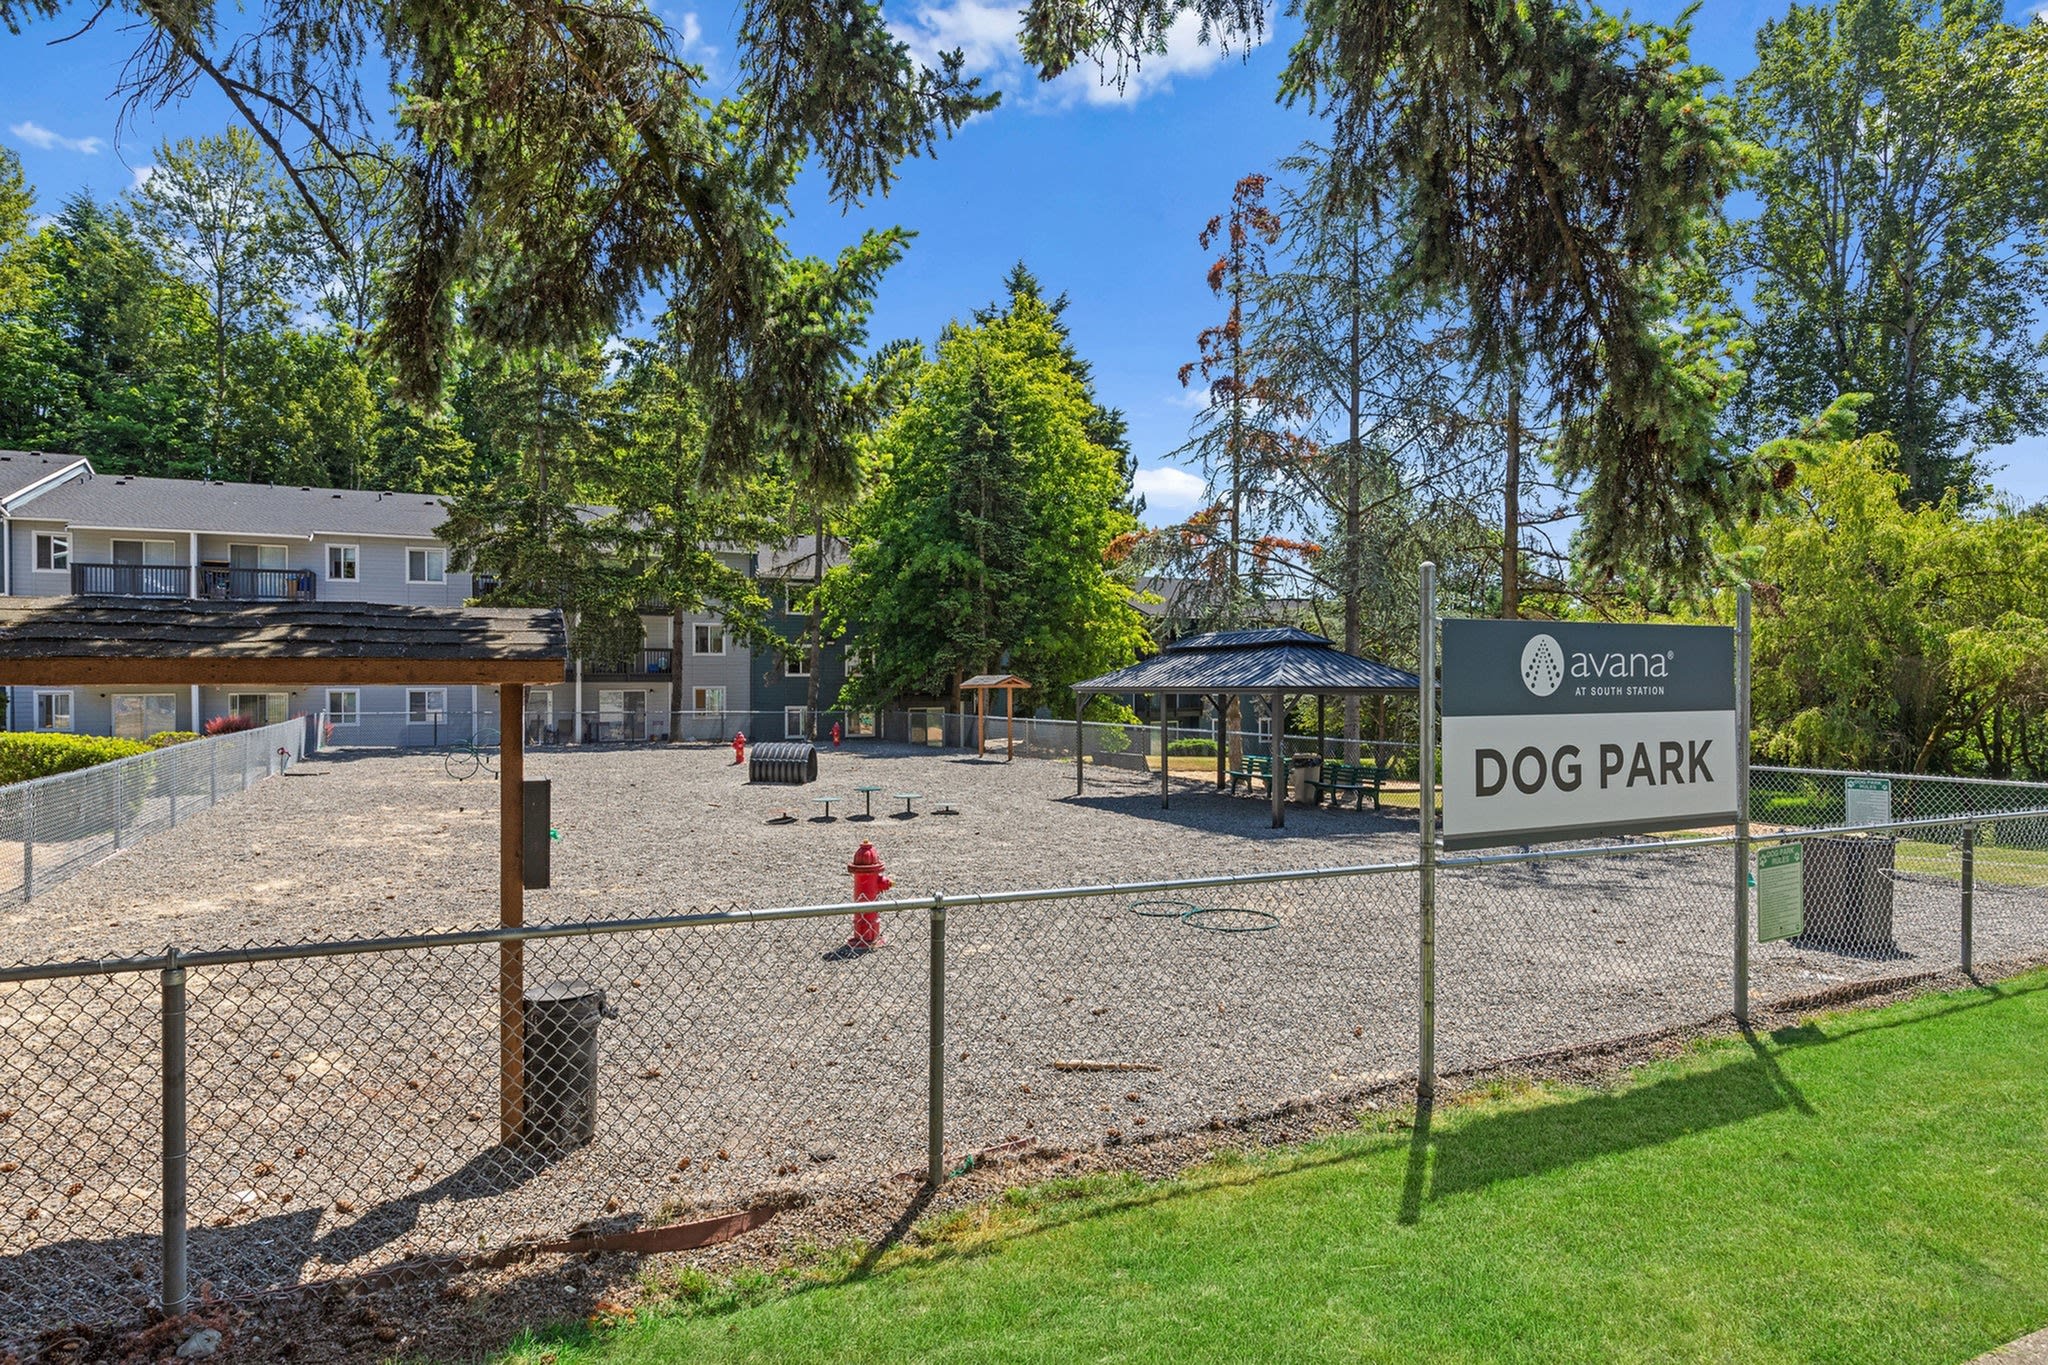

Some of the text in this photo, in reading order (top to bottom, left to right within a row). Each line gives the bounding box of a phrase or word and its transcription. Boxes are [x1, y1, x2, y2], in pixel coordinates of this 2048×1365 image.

[1575, 686, 1665, 696] AT SOUTH STATION
[1475, 739, 1715, 797] DOG PARK
